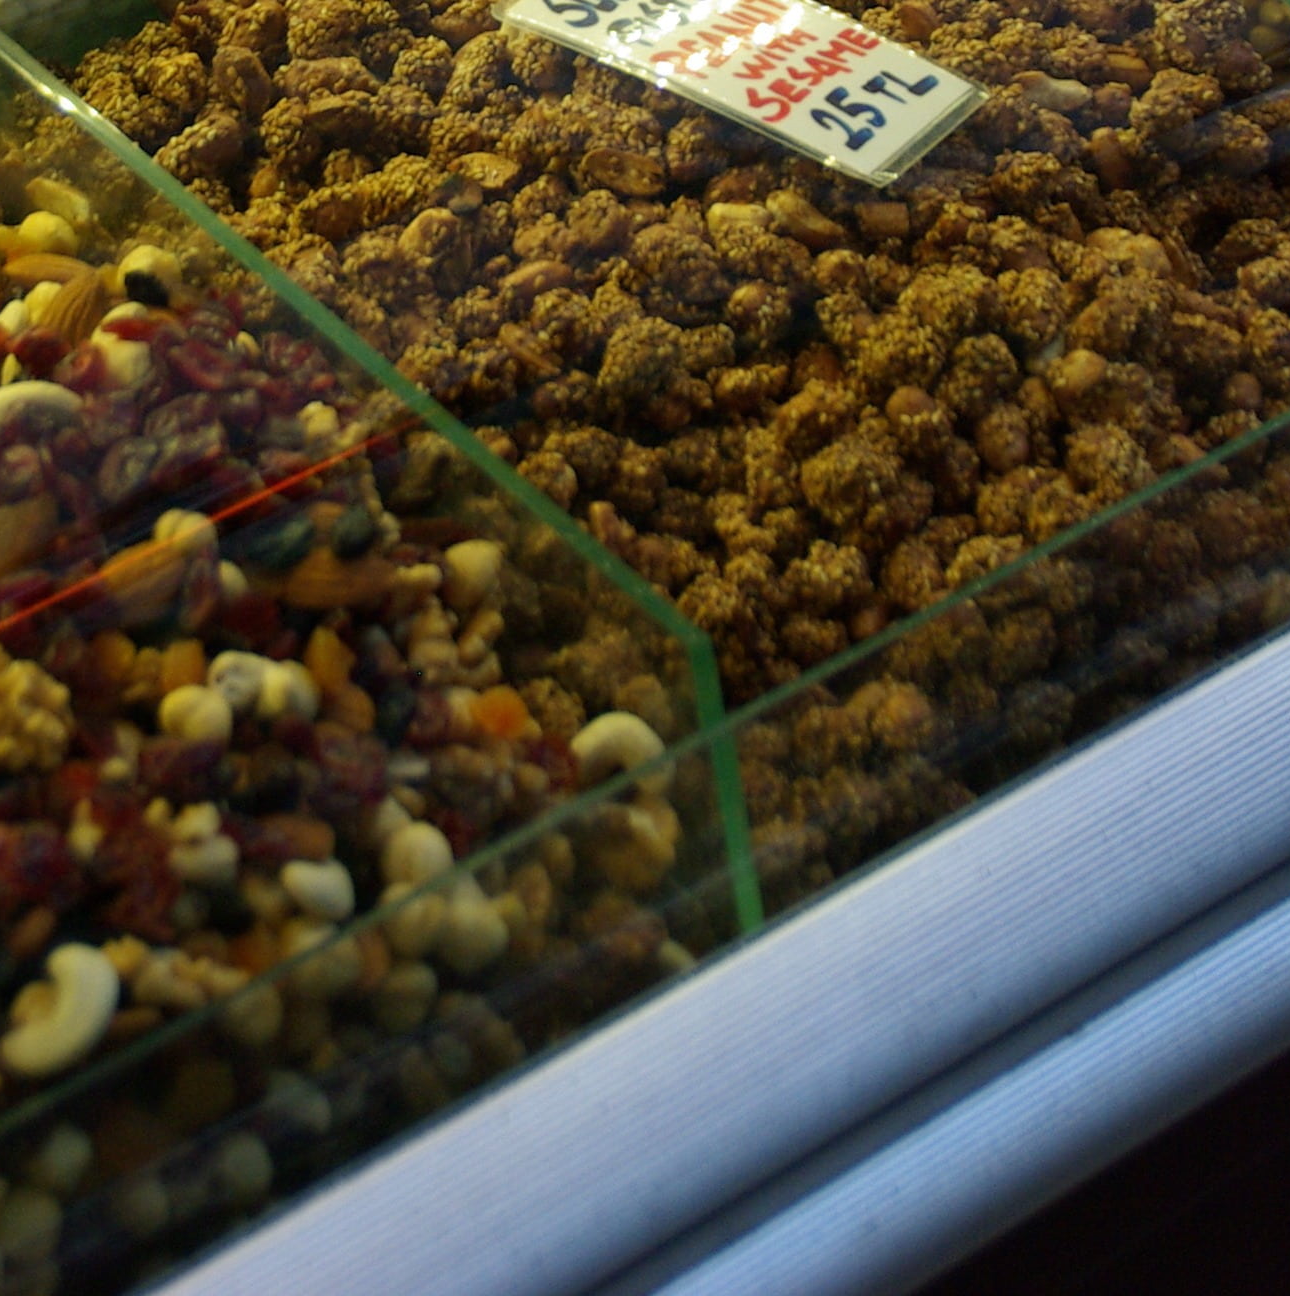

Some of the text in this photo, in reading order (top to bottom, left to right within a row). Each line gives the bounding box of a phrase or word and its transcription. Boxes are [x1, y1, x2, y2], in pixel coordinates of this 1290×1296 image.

[732, 26, 822, 83] WITH
[746, 26, 881, 124] SESAME
[810, 70, 941, 152] 25 TL
